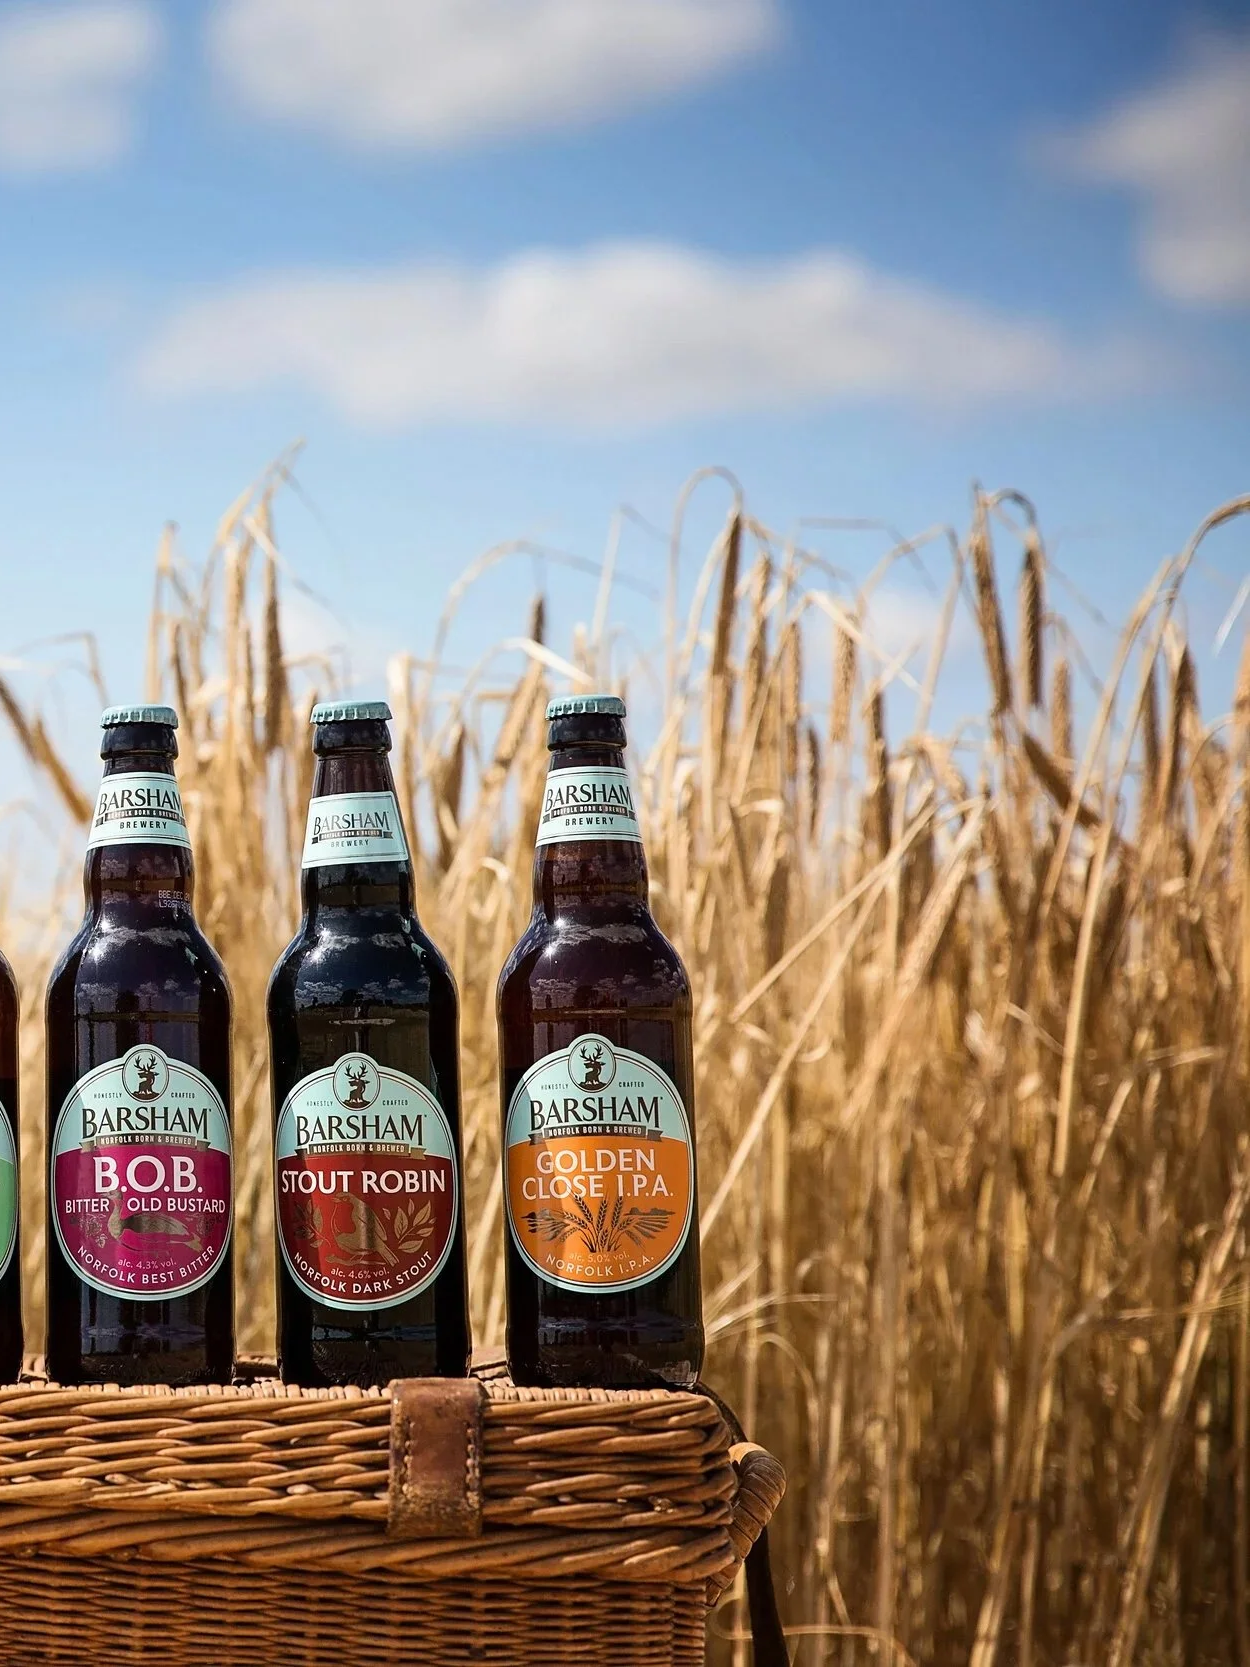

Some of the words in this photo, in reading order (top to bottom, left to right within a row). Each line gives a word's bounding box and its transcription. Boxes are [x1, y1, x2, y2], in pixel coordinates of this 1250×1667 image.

[98, 788, 185, 818] BARSHAM
[545, 784, 634, 812] BARSHAM
[120, 821, 167, 829] BREWERY
[314, 812, 390, 836] BARSHAM
[565, 817, 614, 826] BREWERY
[331, 839, 369, 847] BREWERY
[82, 1107, 208, 1139] BARSHAM
[530, 1097, 660, 1131] BARSHAM
[101, 1135, 132, 1144] NORFOLK
[135, 1135, 154, 1143] BORN
[165, 1136, 192, 1145] BREWED
[297, 1115, 422, 1146] BARSHAM
[549, 1126, 580, 1136] NORFOLK
[614, 1126, 641, 1135] BREWED
[313, 1144, 343, 1153] NORFOLK
[537, 1149, 655, 1174] GOLDEN
[93, 1155, 203, 1193] B.O.B.
[282, 1170, 354, 1194] STOUT
[361, 1170, 445, 1194] ROBIN
[522, 1175, 603, 1200] CLOSE
[617, 1175, 674, 1197] I.P.A.
[65, 1199, 109, 1213] BITTER
[127, 1198, 162, 1211] OLD
[168, 1199, 225, 1213] BUSTARD
[78, 1245, 135, 1283] NORFOLK
[142, 1271, 175, 1284] BEST
[180, 1246, 215, 1278] BITTER
[118, 1258, 132, 1268] alc.
[136, 1261, 158, 1270] 4.3%
[161, 1258, 176, 1267] vol.
[546, 1254, 613, 1276] NORFOLK
[620, 1256, 654, 1274] I.P.A.
[569, 1252, 584, 1262] alc.
[588, 1254, 610, 1263] 5.0%
[614, 1251, 629, 1260] vol.
[294, 1252, 346, 1292] NORFOLK
[352, 1279, 392, 1293] DARK
[396, 1251, 432, 1285] STOUT
[331, 1267, 345, 1277] alc.
[348, 1270, 371, 1279] 4.6%
[373, 1267, 389, 1277] vol.
